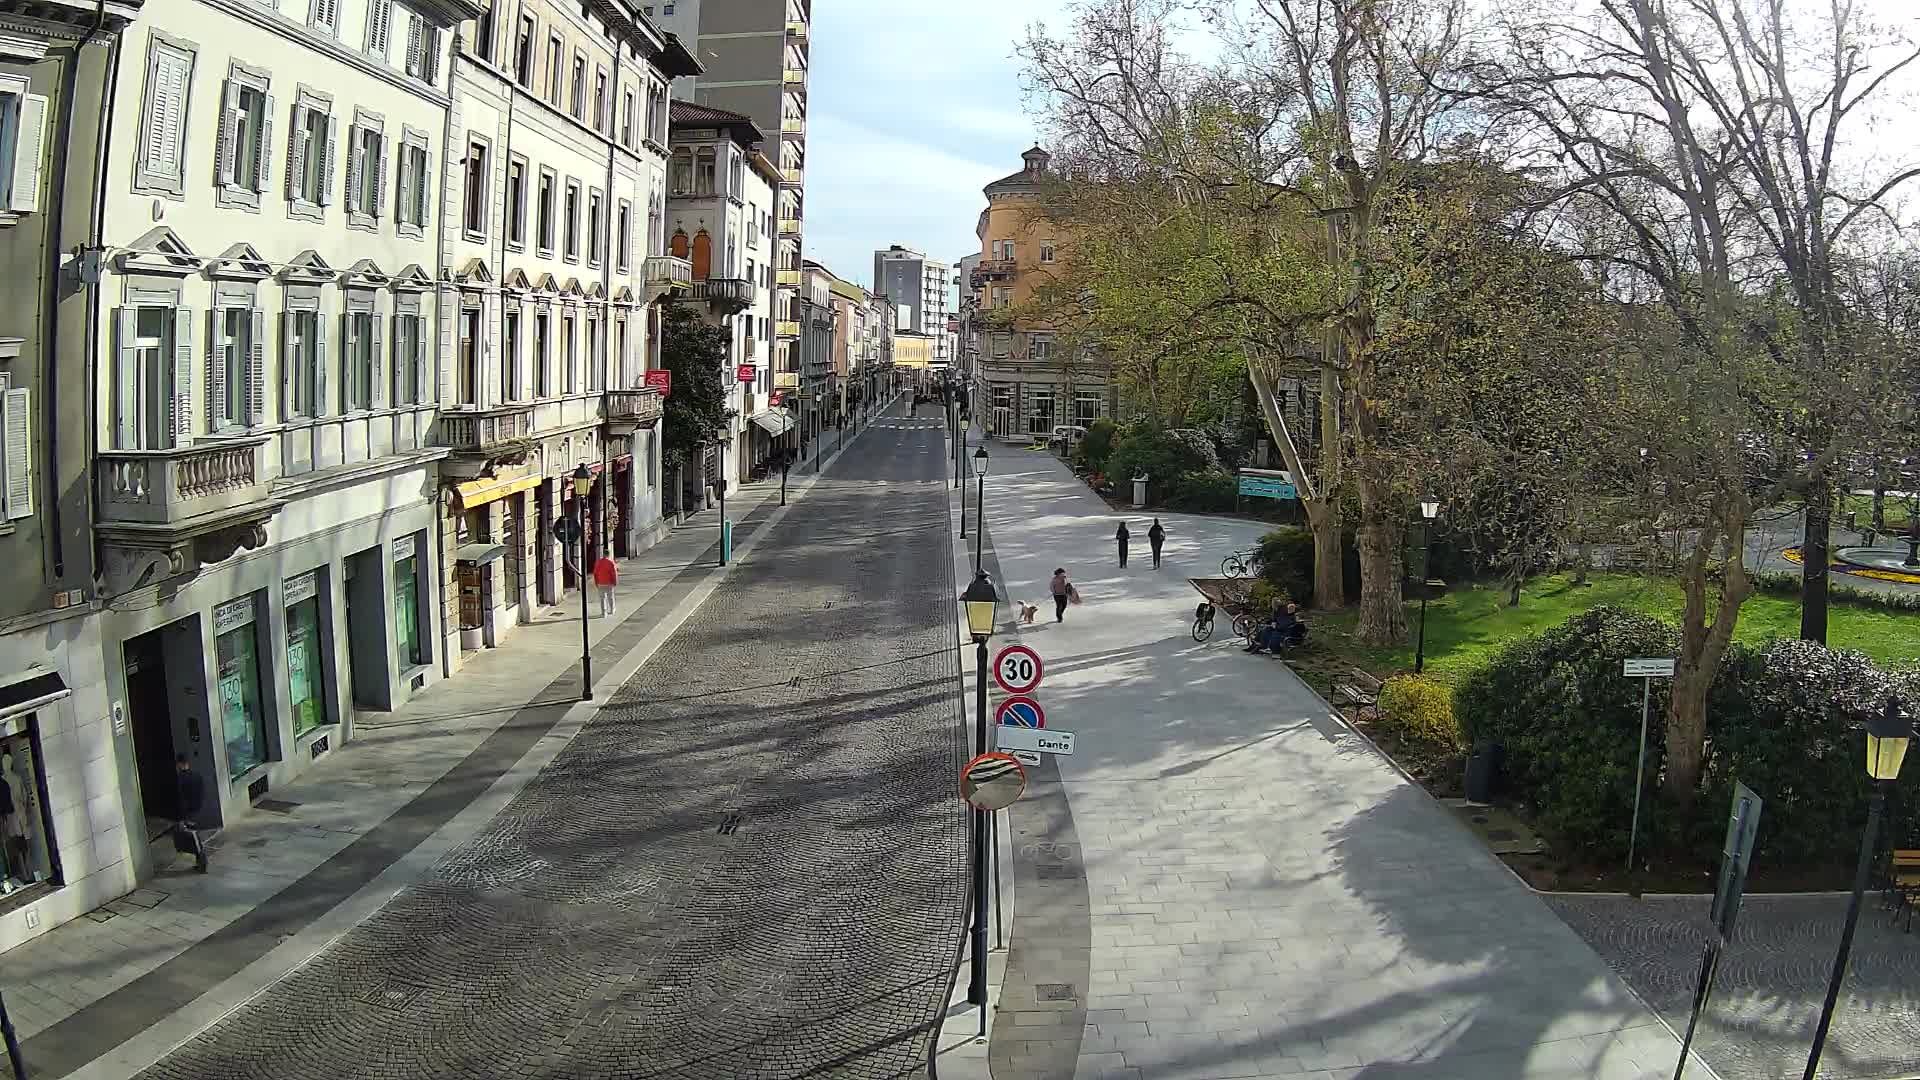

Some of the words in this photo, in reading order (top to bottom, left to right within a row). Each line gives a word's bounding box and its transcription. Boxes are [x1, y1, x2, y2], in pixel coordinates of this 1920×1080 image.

[1004, 658, 1033, 681] 30
[221, 678, 240, 702] 130
[1038, 738, 1070, 750] Dante
